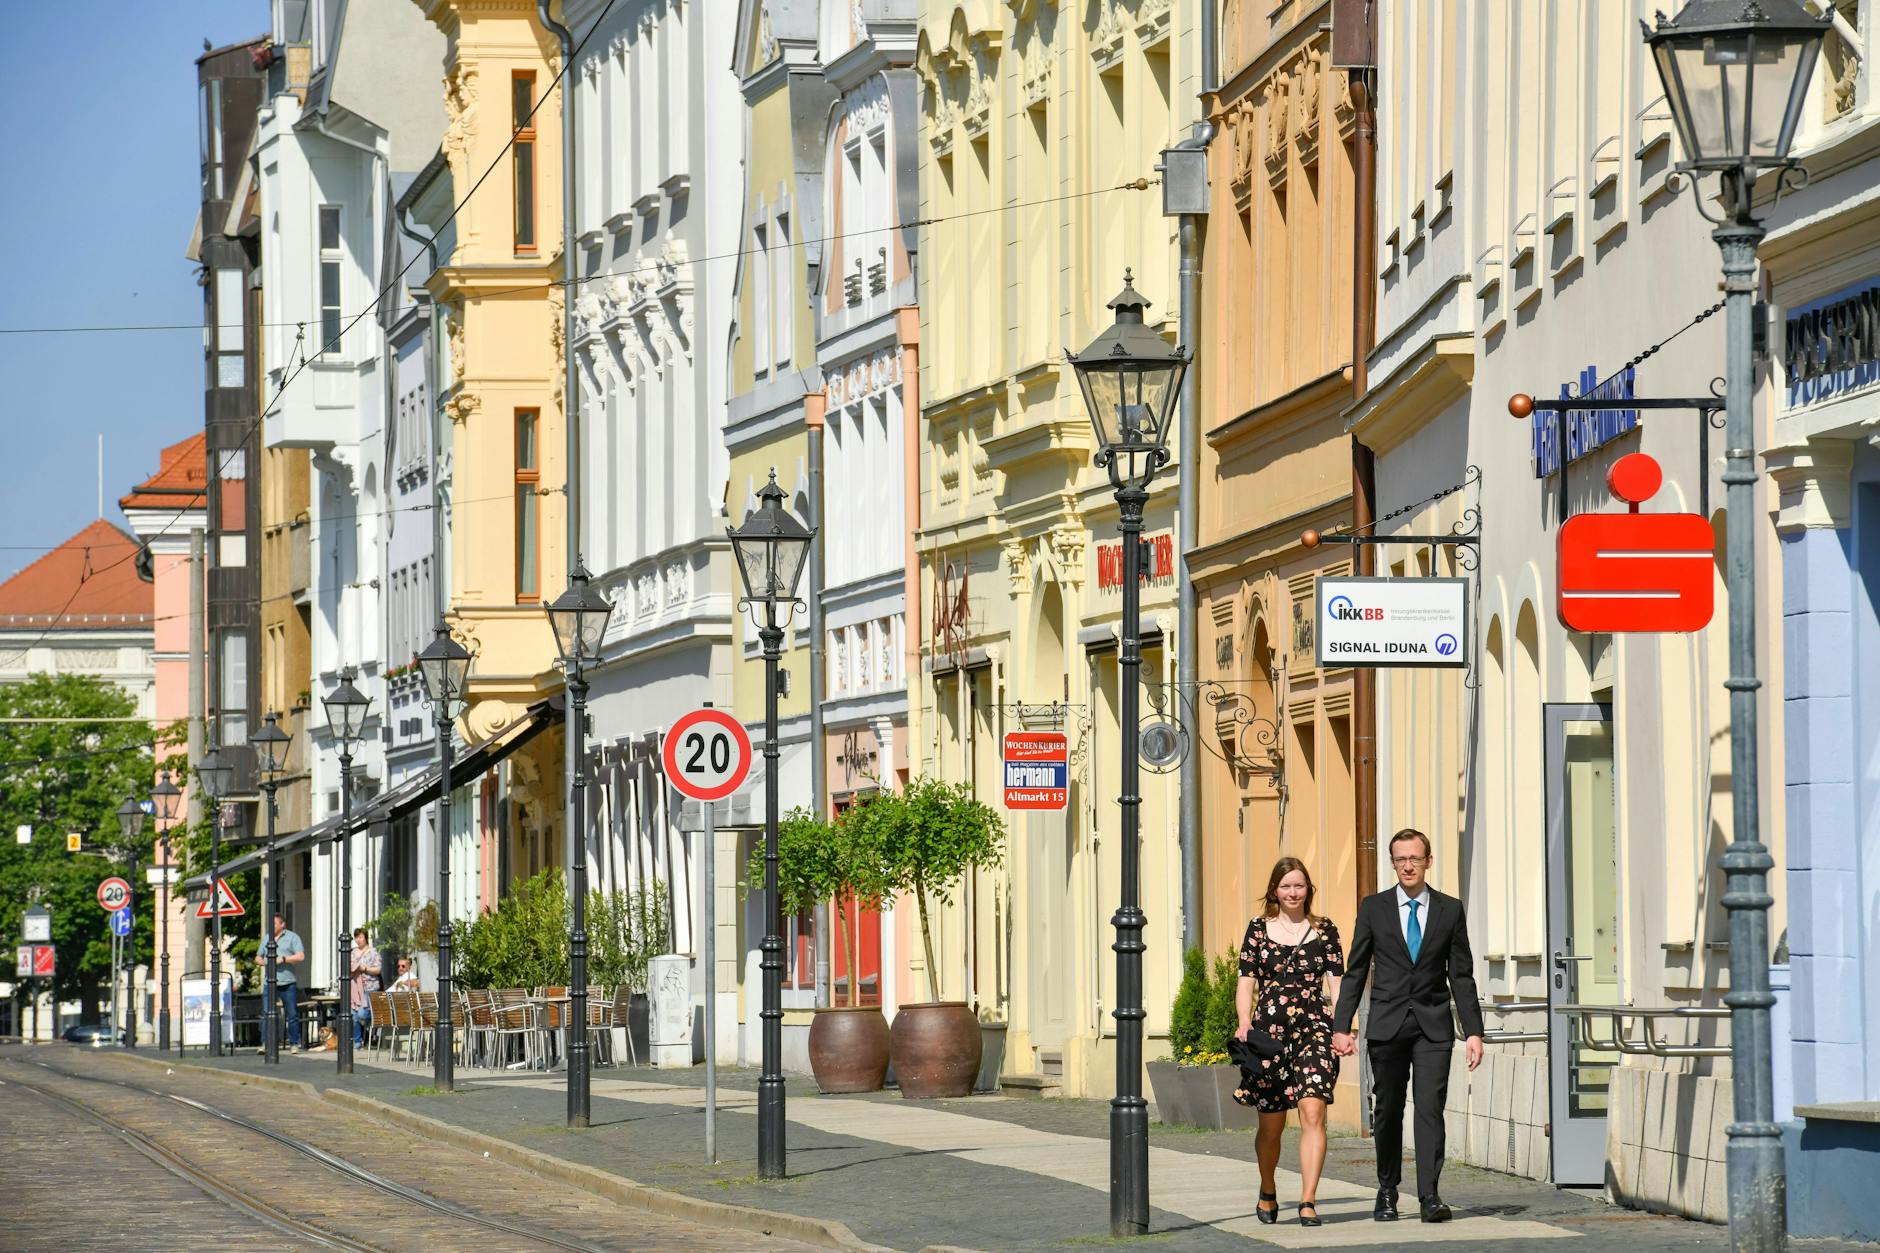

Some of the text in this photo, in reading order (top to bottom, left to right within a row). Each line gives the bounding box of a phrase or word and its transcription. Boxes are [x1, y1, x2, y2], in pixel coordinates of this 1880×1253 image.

[1329, 642, 1428, 654] SIGNAL IDUNA
[1006, 741, 1065, 750] WOCHENKURIER
[685, 732, 730, 773] 20
[1006, 763, 1055, 787] hermann
[1007, 791, 1064, 801] Altmarkt 15
[106, 887, 124, 902] 20
